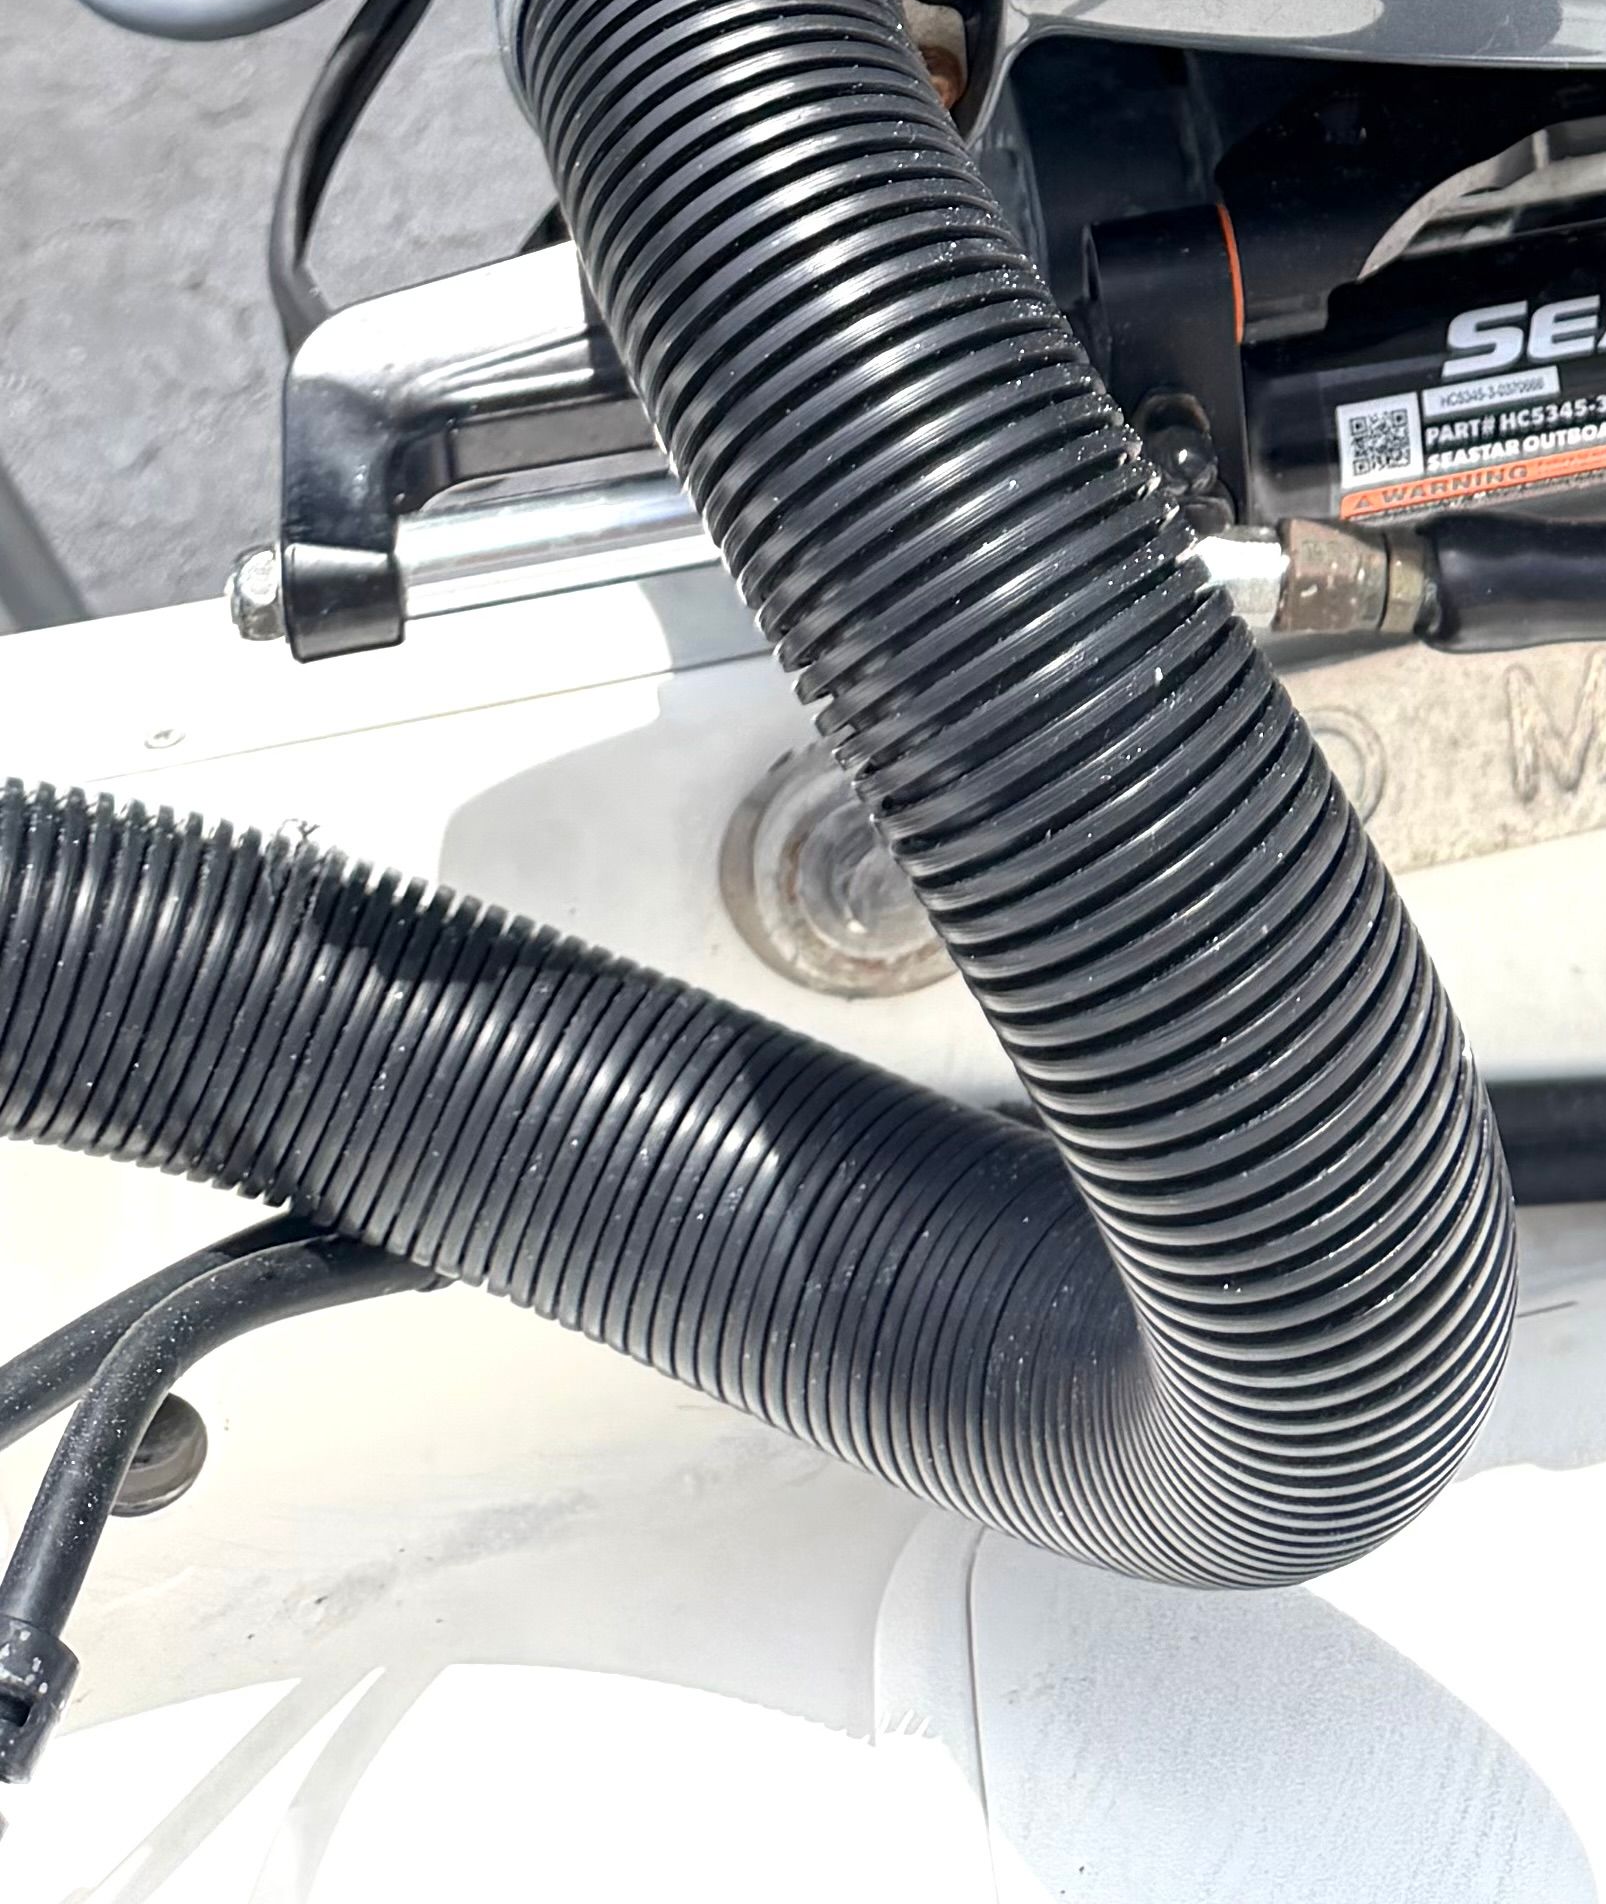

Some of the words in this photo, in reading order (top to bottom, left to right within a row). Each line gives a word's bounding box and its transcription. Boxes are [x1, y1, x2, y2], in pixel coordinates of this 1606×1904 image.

[1425, 416, 1498, 446] PART#
[1426, 439, 1522, 472] SEASTAR
[1380, 464, 1529, 504] WARNING
